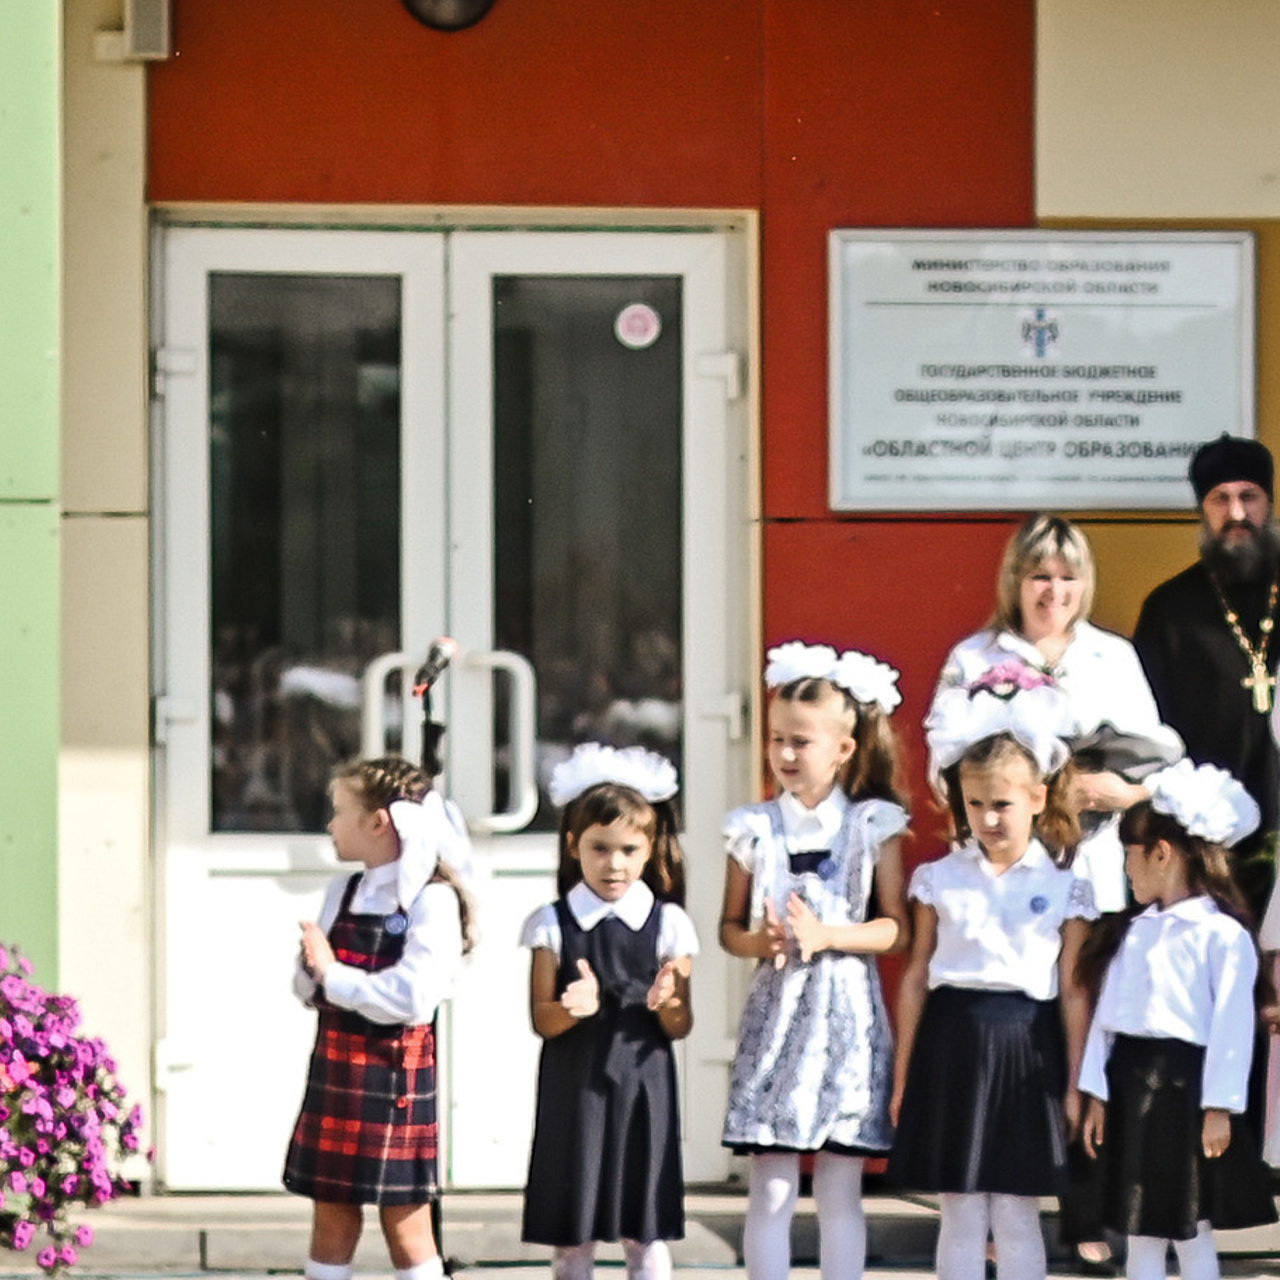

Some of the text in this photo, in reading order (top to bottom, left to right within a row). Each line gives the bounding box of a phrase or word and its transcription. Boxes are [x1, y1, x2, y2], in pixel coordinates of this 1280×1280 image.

[911, 259, 1171, 274] МИНИСТЕРСТВО ОБРАЗОВАНИЯ
[927, 279, 1159, 295] НОВОСИБИРСКОЙ ОБЛАСТИ
[920, 364, 1157, 379] ГОСУДАРСТВЕННОЕ БЮДЖЕТНОЕ
[894, 389, 1183, 404] ОБЩЕОБРАЗОВАТЕЛЬНОЕ УЧРЕЖДЕНИЕ
[936, 412, 1141, 428] НОВОСИБИРСКОЙ ОБЛАСТИ
